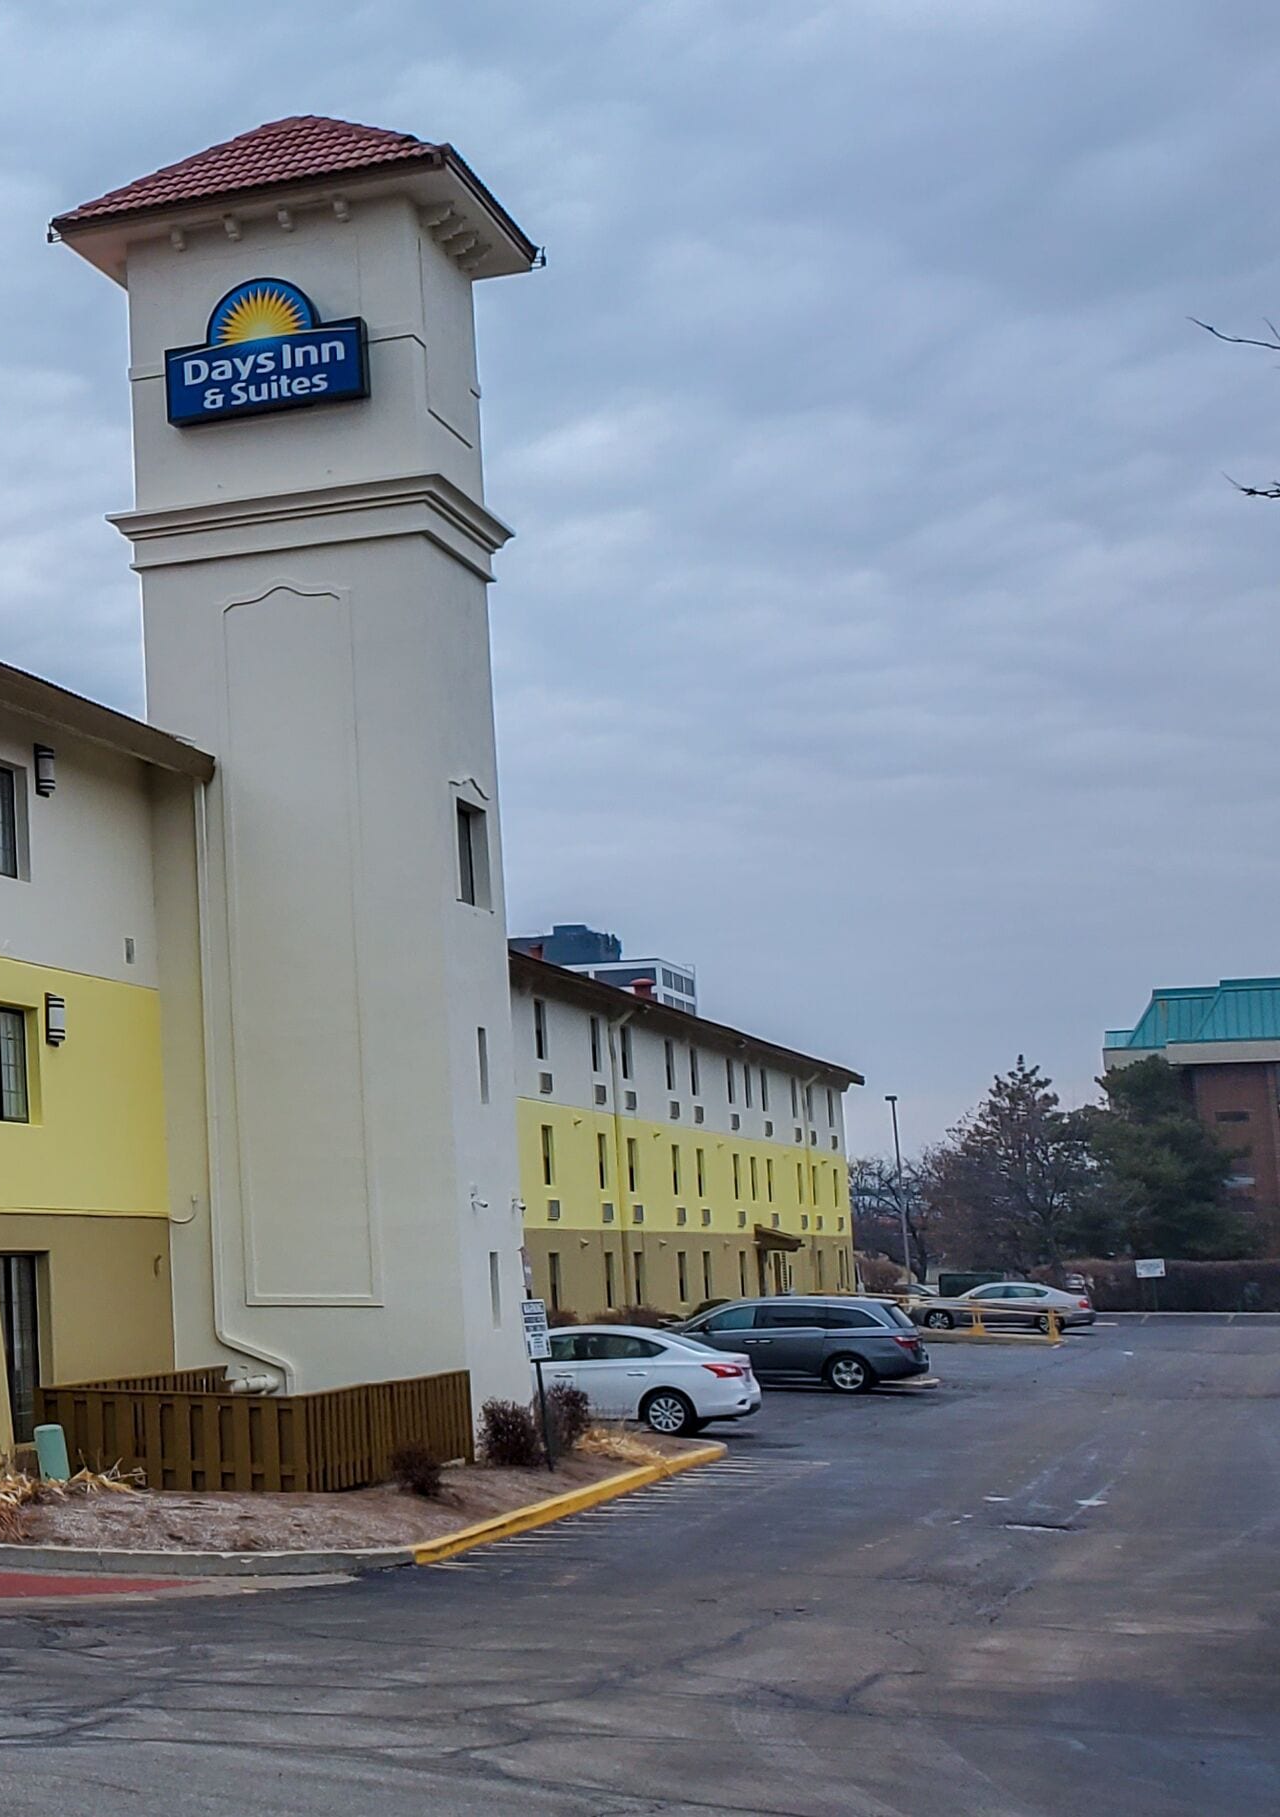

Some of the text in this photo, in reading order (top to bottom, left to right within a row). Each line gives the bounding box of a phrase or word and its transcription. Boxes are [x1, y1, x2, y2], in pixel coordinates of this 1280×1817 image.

[183, 339, 345, 386] Days Inn
[203, 371, 329, 409] & Suites
